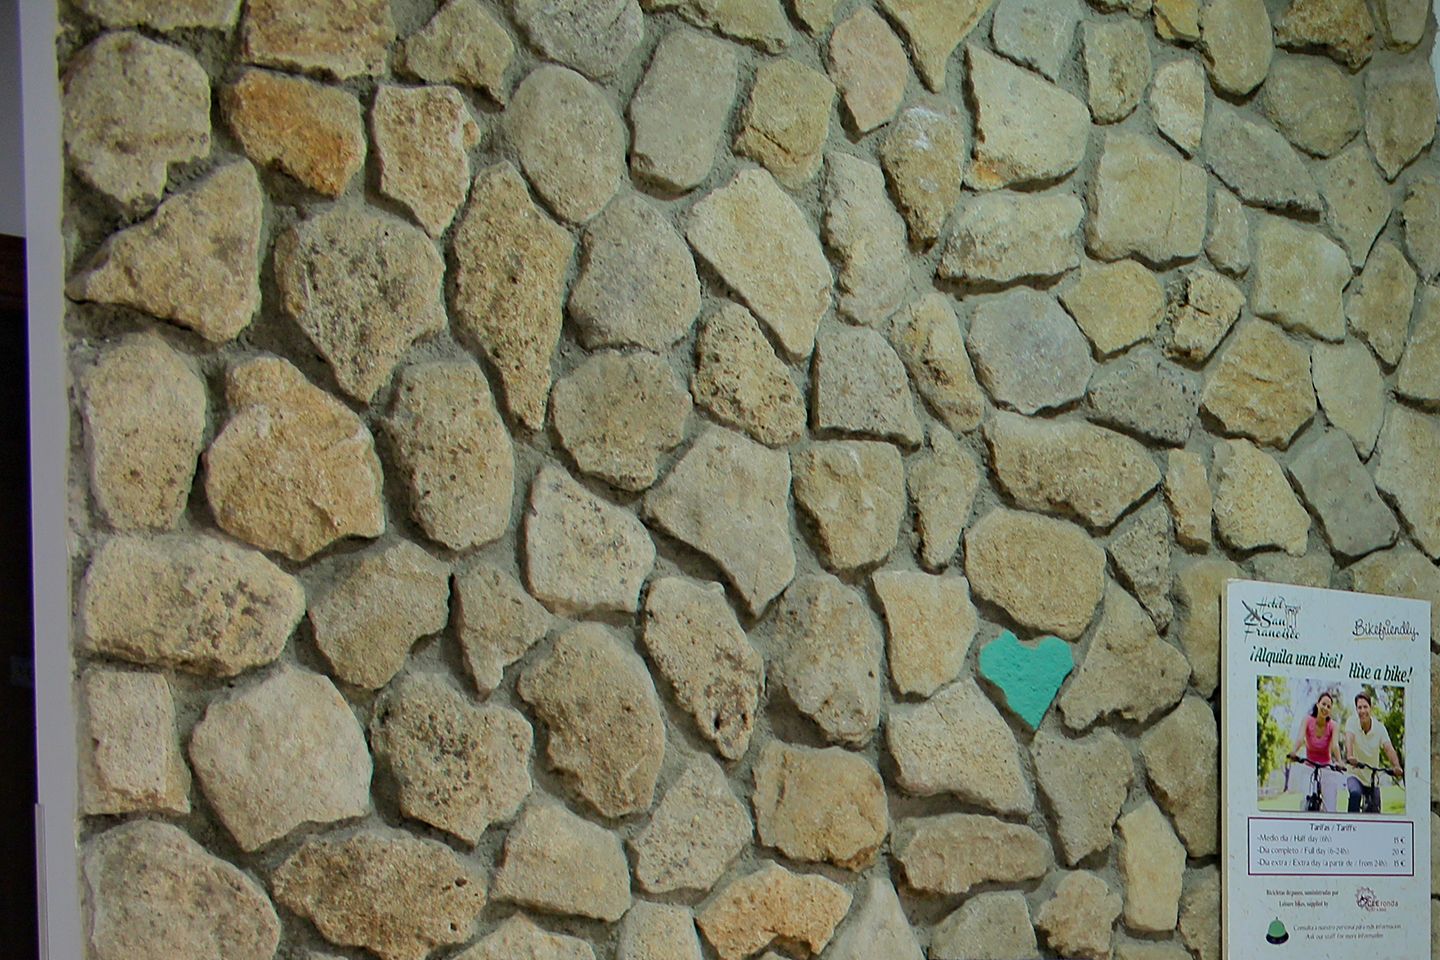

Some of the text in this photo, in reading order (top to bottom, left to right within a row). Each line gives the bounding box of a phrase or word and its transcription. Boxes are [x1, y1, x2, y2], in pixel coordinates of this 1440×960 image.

[1260, 611, 1286, 628] San
[1250, 646, 1343, 669] ¡Alquila una bici!
[1349, 662, 1413, 683] Hire a bike!
